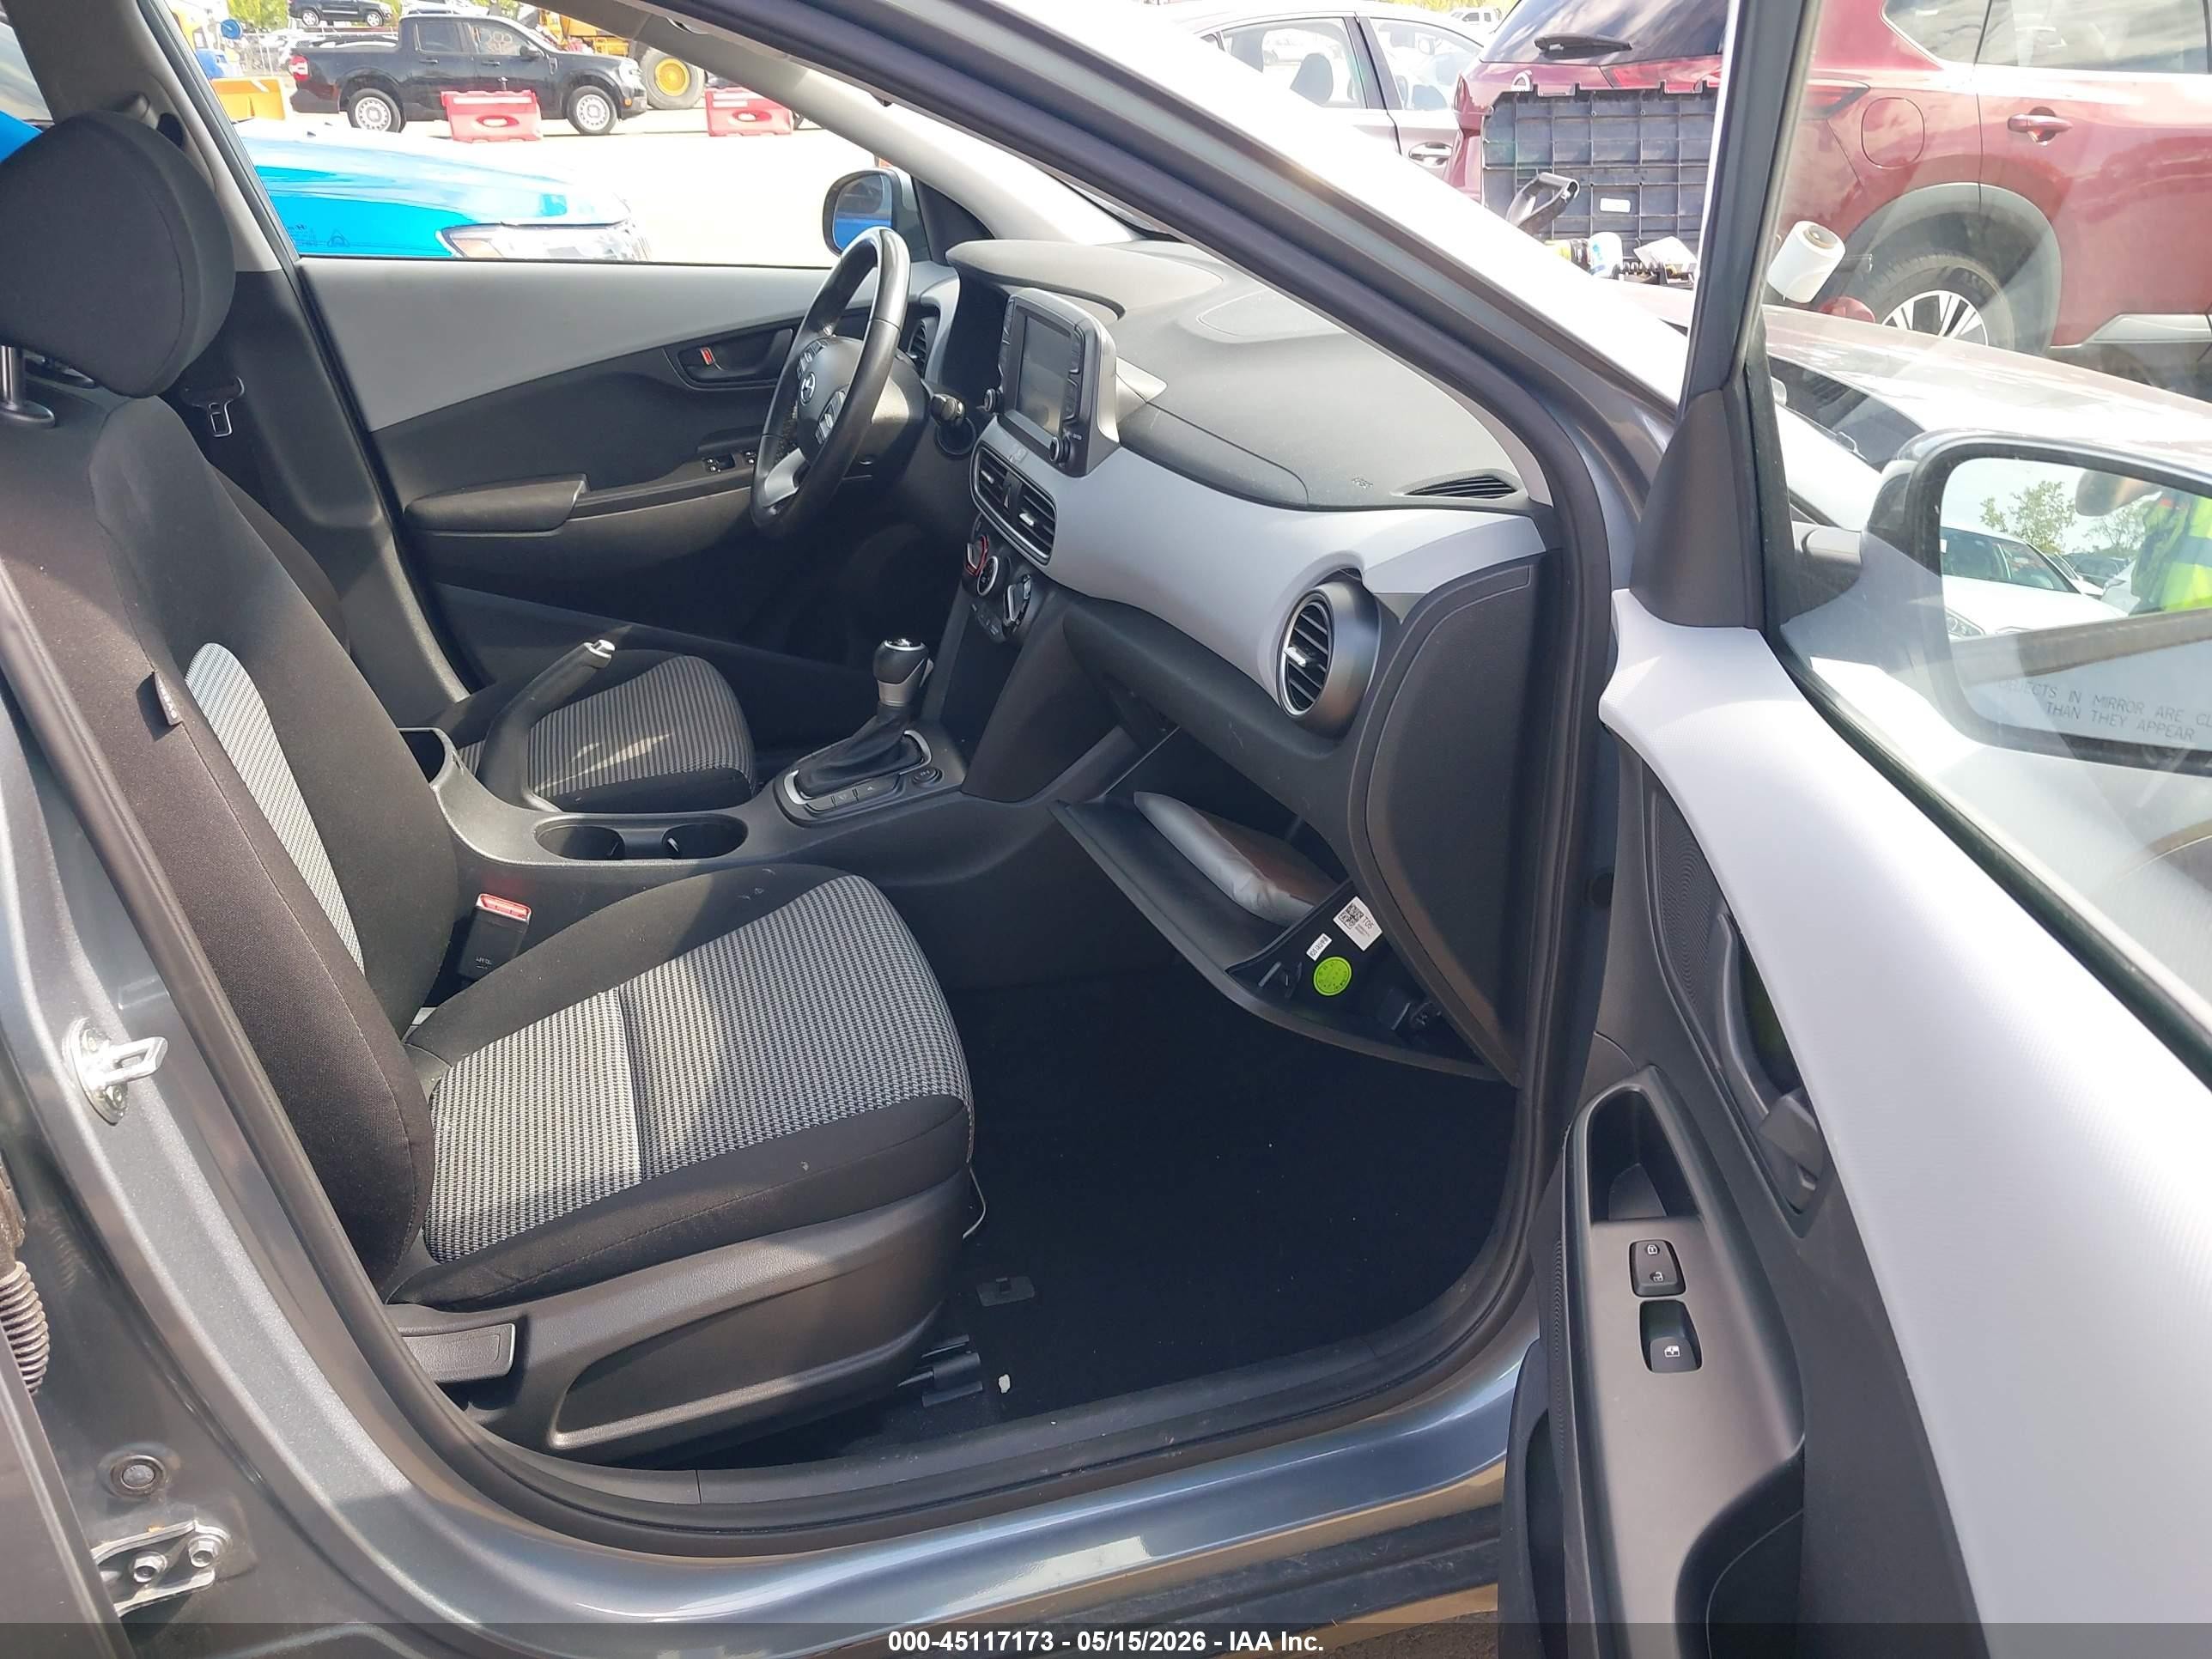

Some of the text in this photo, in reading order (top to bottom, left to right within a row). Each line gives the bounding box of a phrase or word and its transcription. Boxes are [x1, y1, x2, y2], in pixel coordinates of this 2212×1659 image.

[2045, 701, 2196, 741] THAN THEY APPEAR
[2068, 690, 2082, 704] IN
[2092, 694, 2145, 715] MIRROR
[2154, 705, 2185, 723] ARE
